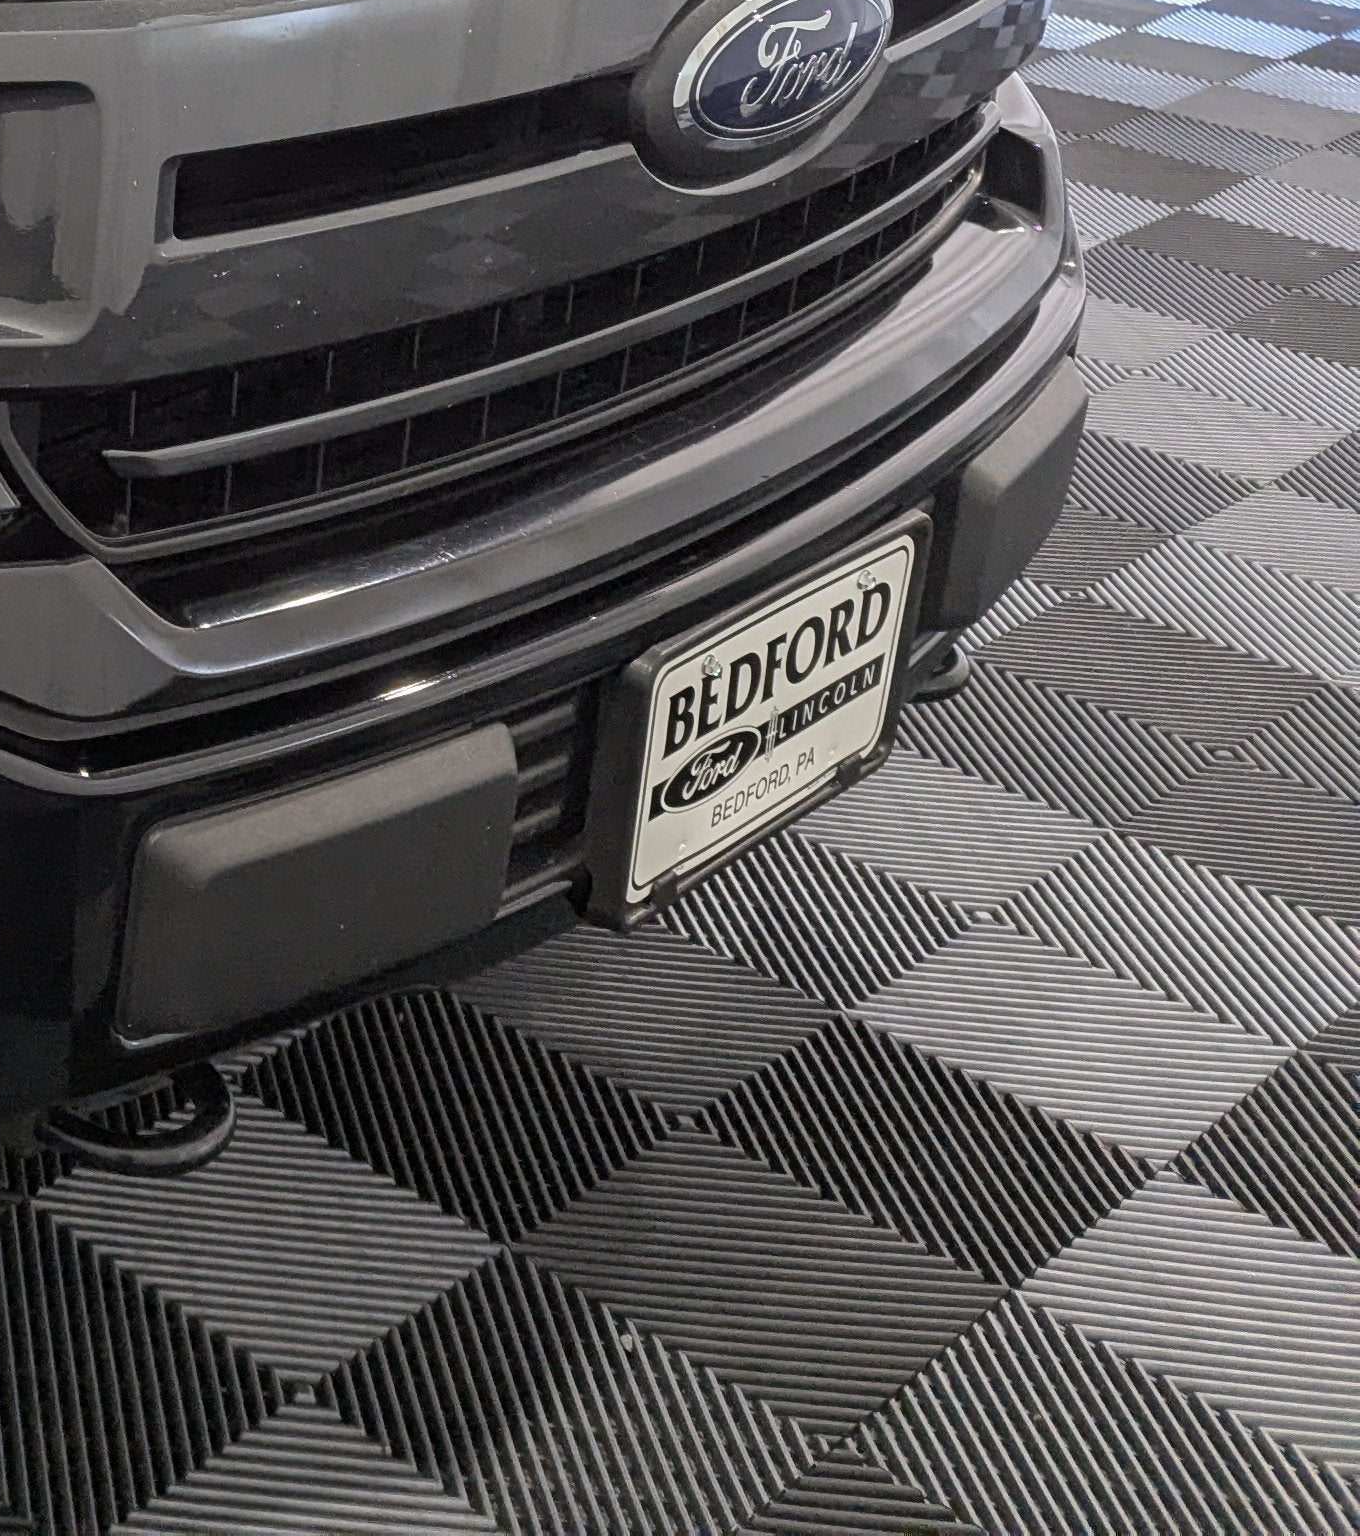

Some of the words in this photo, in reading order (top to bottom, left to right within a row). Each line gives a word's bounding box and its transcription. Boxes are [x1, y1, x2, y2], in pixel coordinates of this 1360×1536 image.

[739, 8, 859, 118] Ford
[661, 581, 892, 761] BEDFORD
[778, 663, 877, 739] LINCOLN
[682, 739, 745, 801] Ford
[710, 757, 793, 828] BEDFORD,
[795, 747, 815, 777] PA
